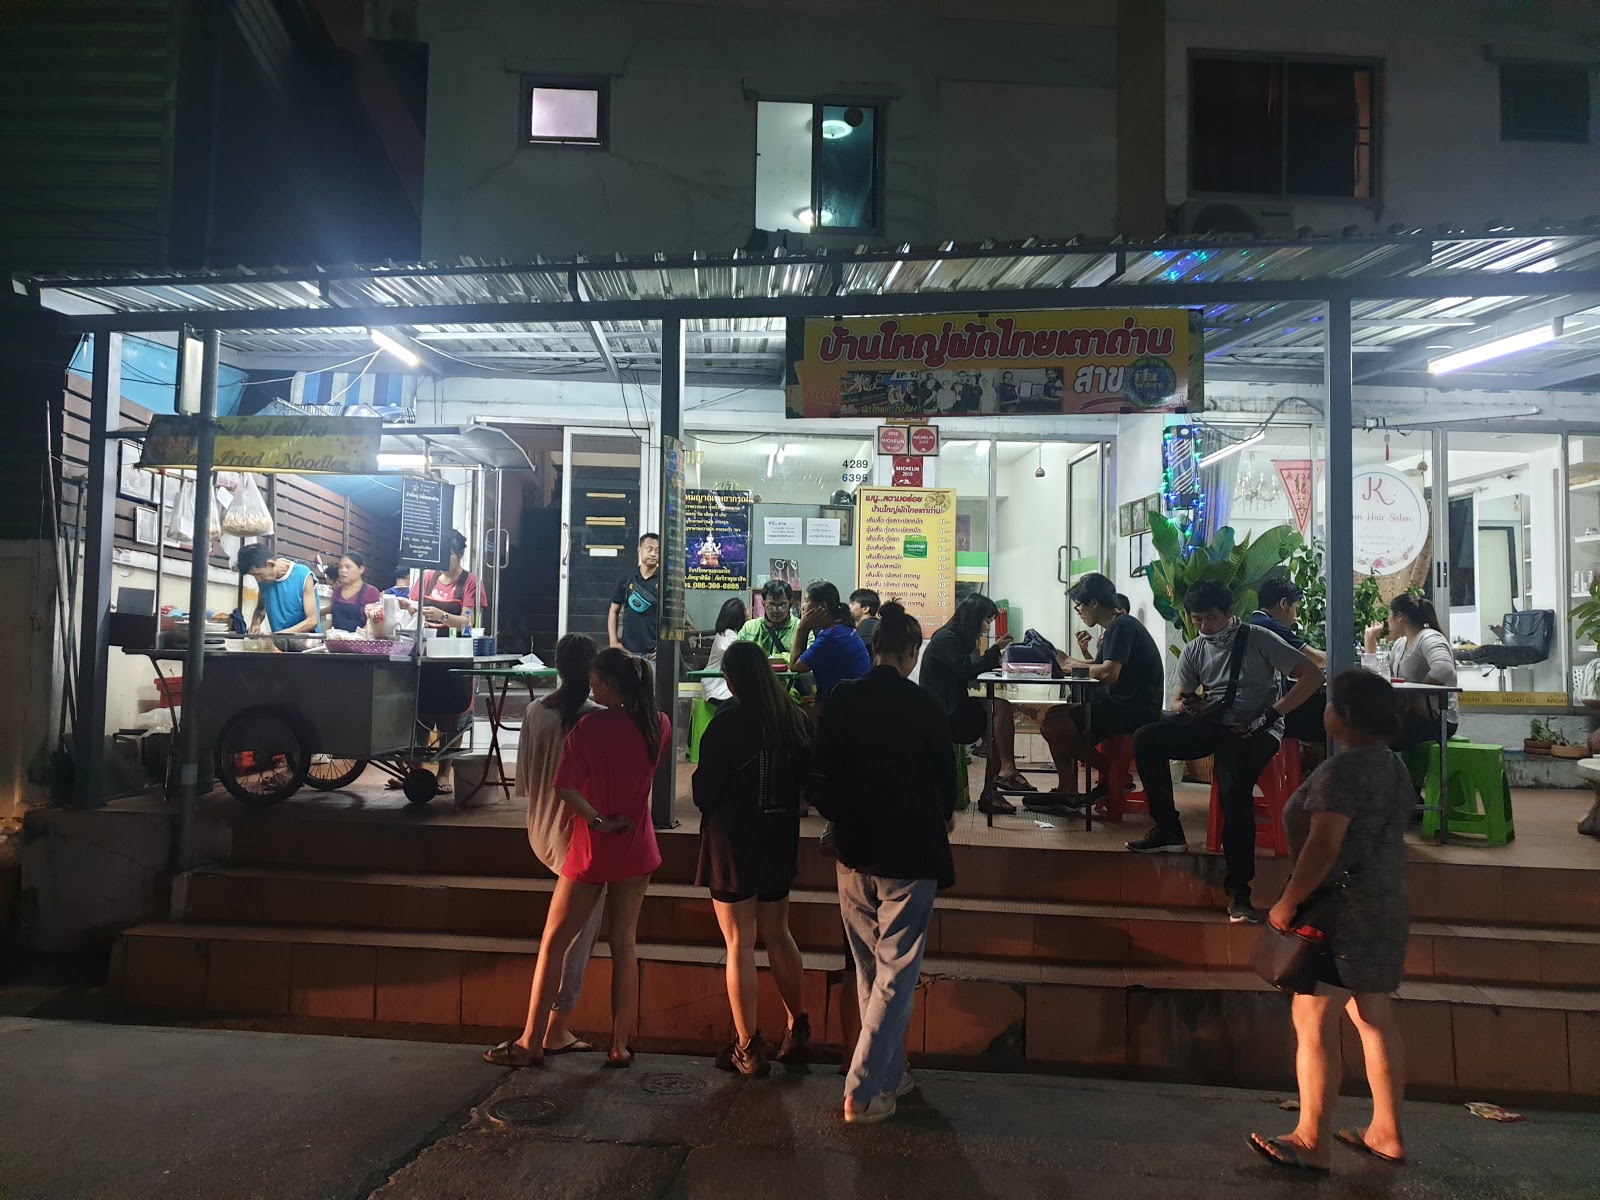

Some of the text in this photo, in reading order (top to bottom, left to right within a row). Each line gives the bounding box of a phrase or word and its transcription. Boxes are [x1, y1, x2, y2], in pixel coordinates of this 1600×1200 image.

[818, 316, 1174, 368] บ้านใหญ่ผัดไทยเตาถ่าน
[217, 450, 265, 466] Fried
[277, 453, 350, 471] Noodles
[842, 459, 869, 469] 4289
[842, 473, 868, 482] 6395
[1367, 512, 1386, 522] Hair
[1388, 513, 1413, 522] Salon
